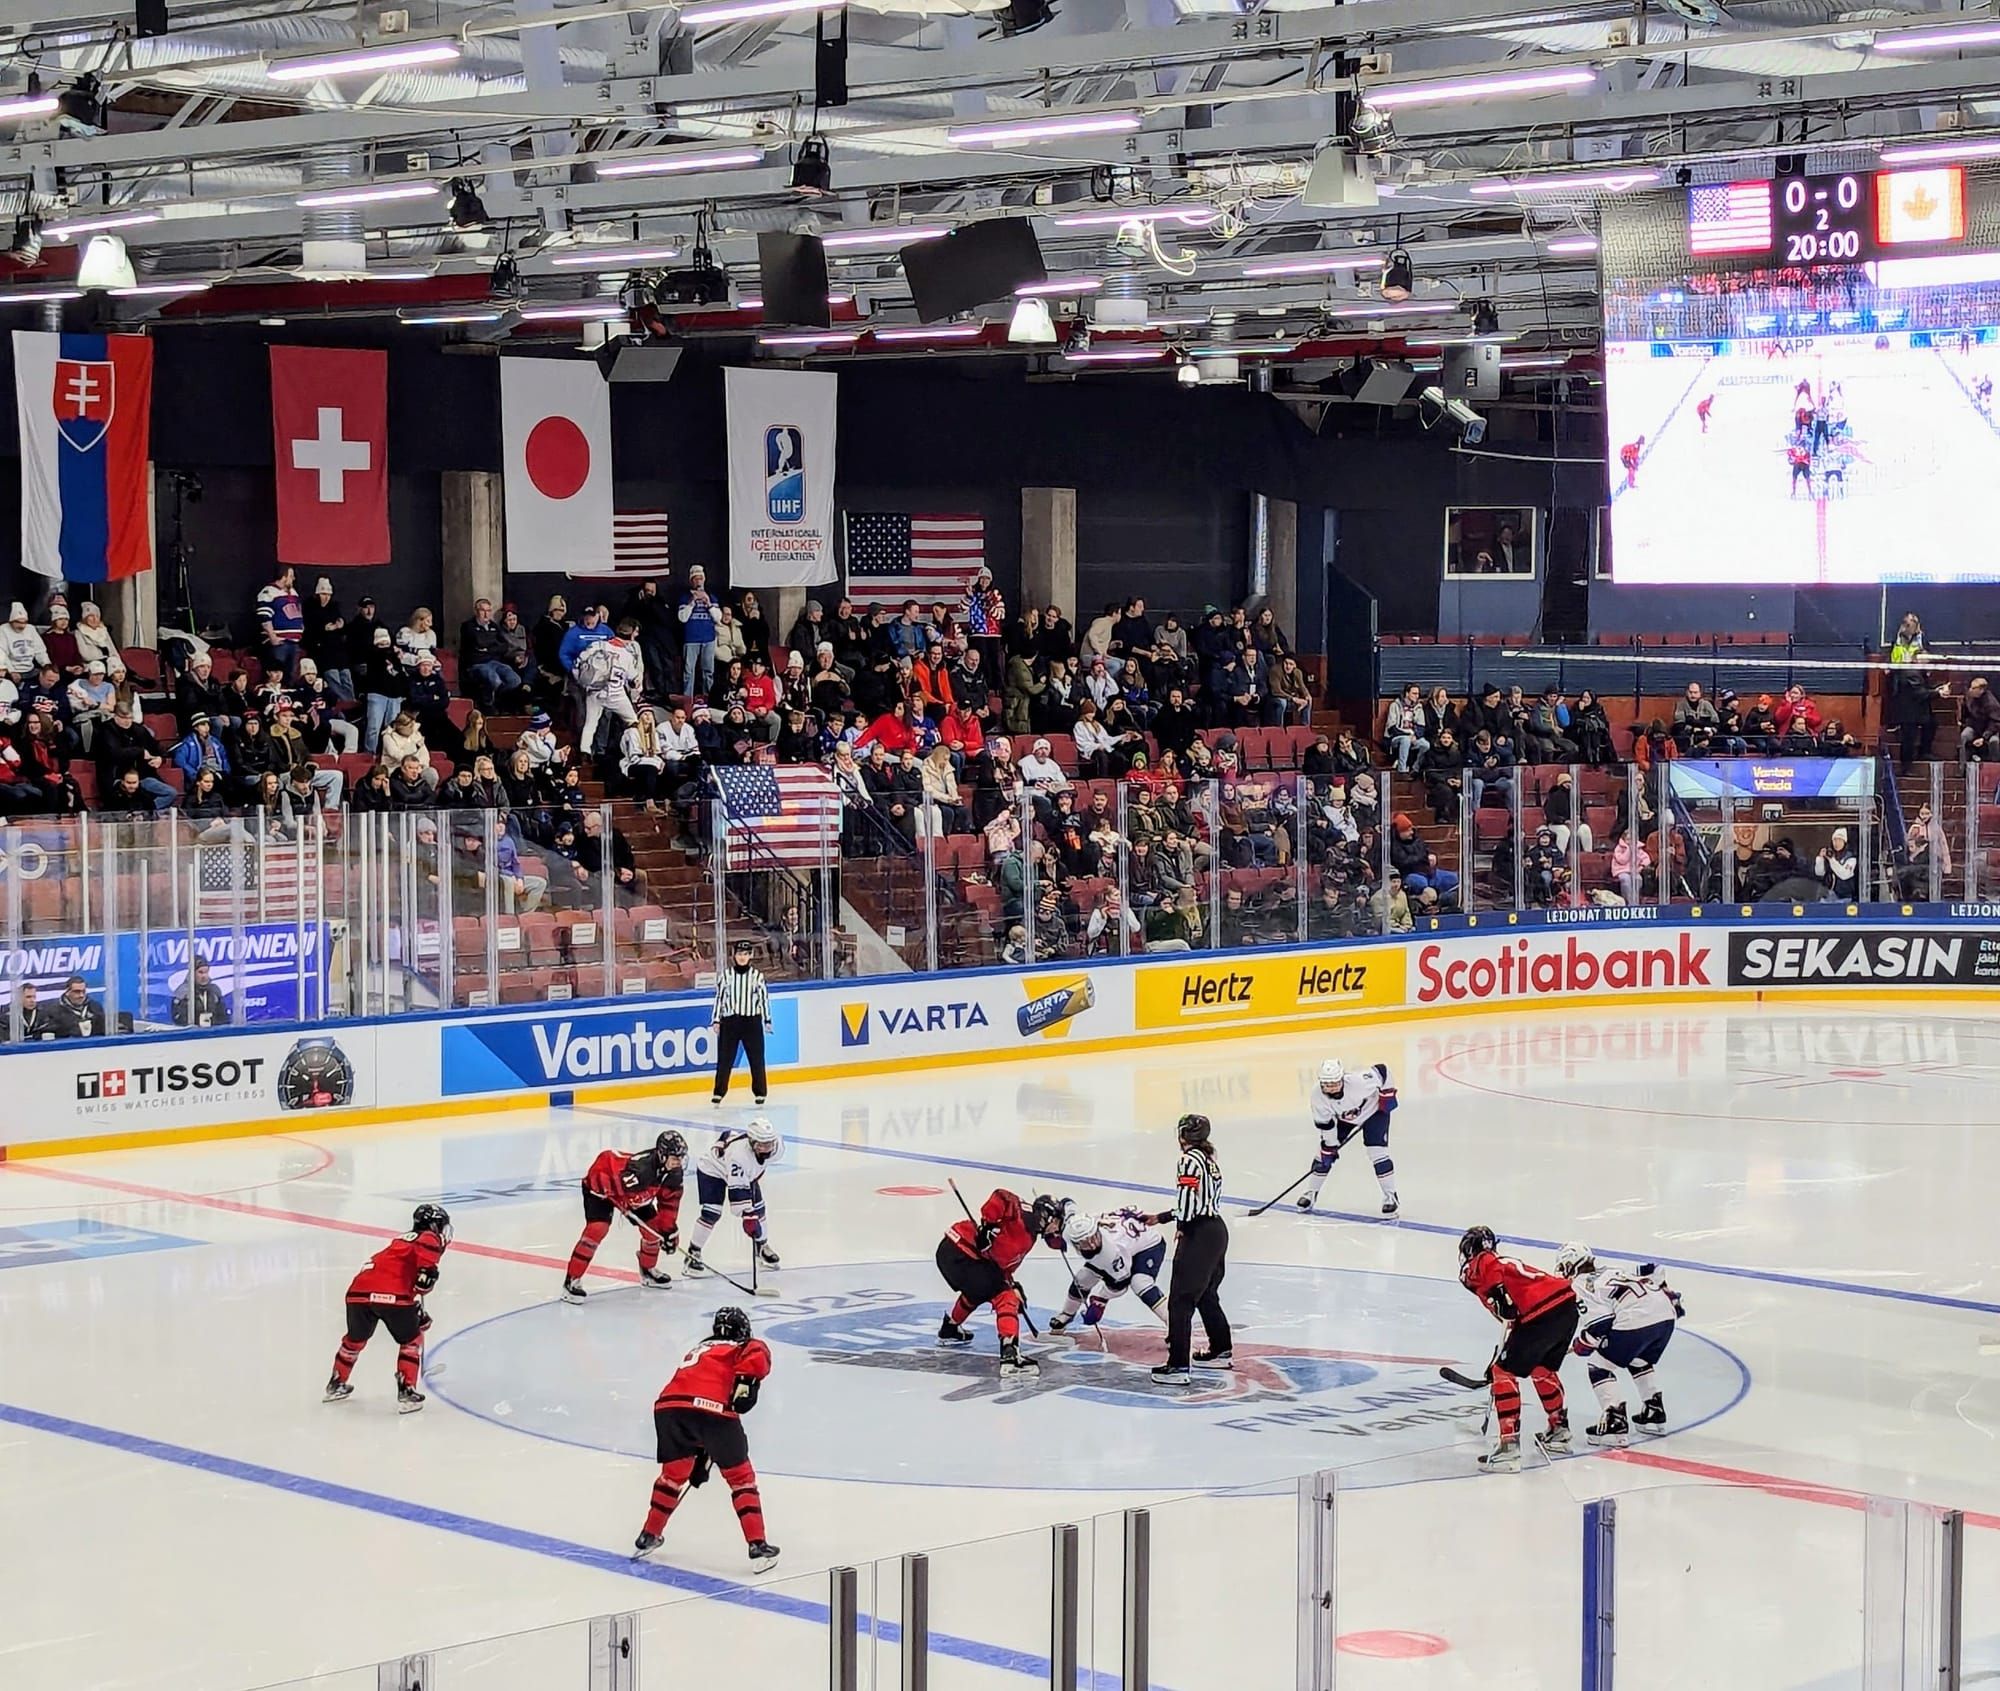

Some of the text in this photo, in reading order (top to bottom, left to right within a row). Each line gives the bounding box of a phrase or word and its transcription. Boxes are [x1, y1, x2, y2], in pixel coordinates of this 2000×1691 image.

[1786, 181, 1806, 213] 0
[1838, 176, 1858, 209] 0
[1816, 208, 1830, 231] 2
[1786, 230, 1860, 261] 20:00
[771, 500, 801, 513] IIHF
[751, 529, 822, 538] INTERNATIONAL
[751, 540, 823, 551] ICE HOCKEY
[759, 552, 816, 561] FEDERATION
[1547, 907, 1658, 923] LEIJONAT RUOKKII
[1417, 932, 1712, 1002] Scotiabank
[1742, 937, 1963, 979] SEKASIN
[1181, 972, 1254, 1006] Hertz
[1297, 962, 1367, 995] Hertz
[878, 1001, 989, 1035] VARTA
[1027, 990, 1069, 1015] VARTA
[531, 1021, 719, 1079] Vantaa
[132, 1057, 264, 1094] TISSOT
[76, 1103, 117, 1115] SWISS
[124, 1096, 186, 1111] WATCHES
[192, 1091, 231, 1105] SINCE
